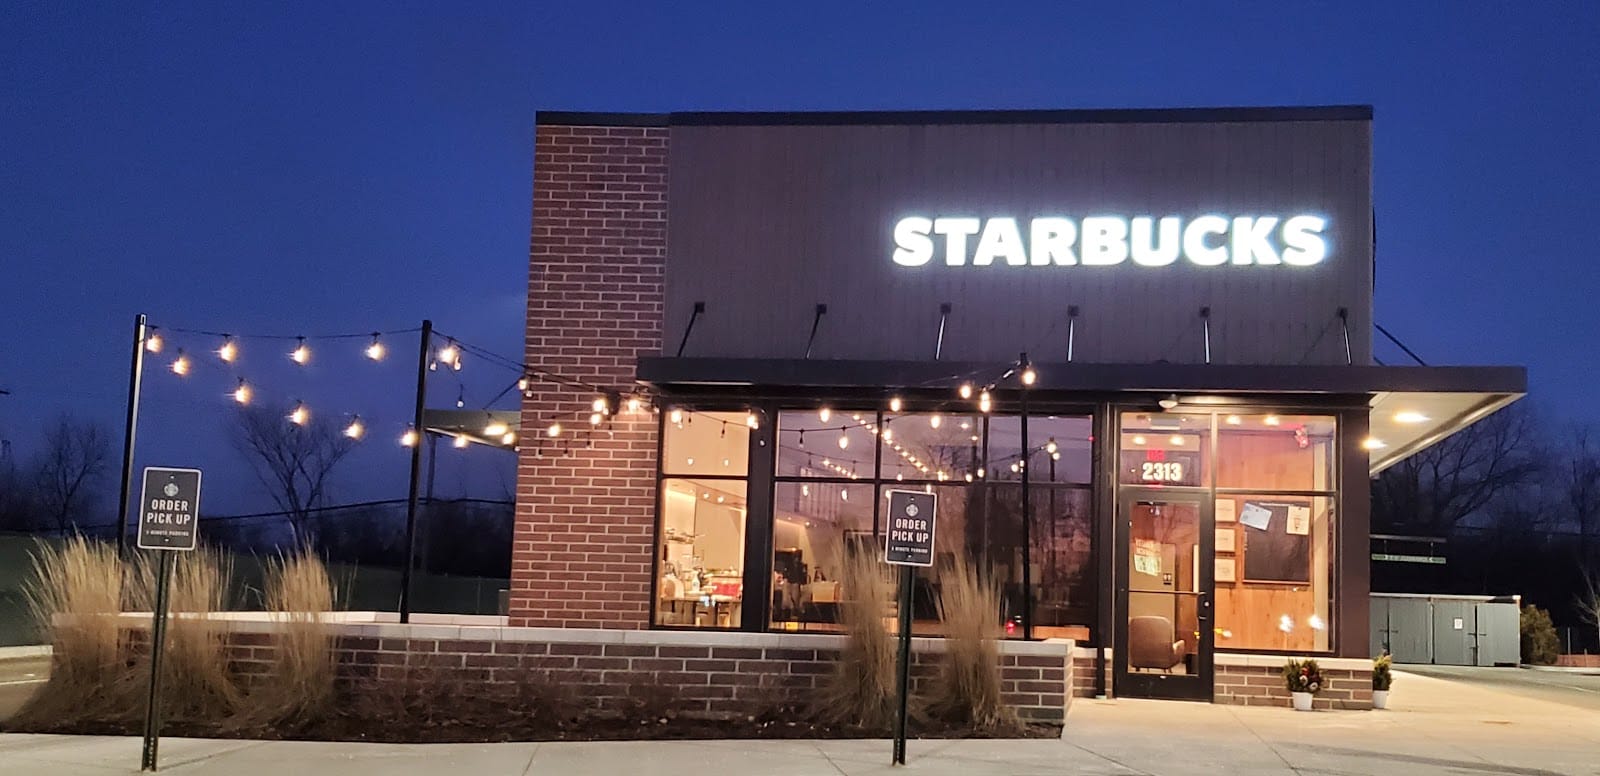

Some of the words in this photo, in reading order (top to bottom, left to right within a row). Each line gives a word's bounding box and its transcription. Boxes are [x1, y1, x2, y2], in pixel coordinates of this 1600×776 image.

[892, 214, 1326, 267] STARBUCKS
[1142, 462, 1182, 481] 2313
[151, 499, 188, 512] ORDER
[146, 512, 172, 524] PICK
[176, 513, 191, 525] UP
[895, 518, 927, 530] ORDER
[891, 530, 914, 542] PICK
[916, 532, 929, 543] UP
